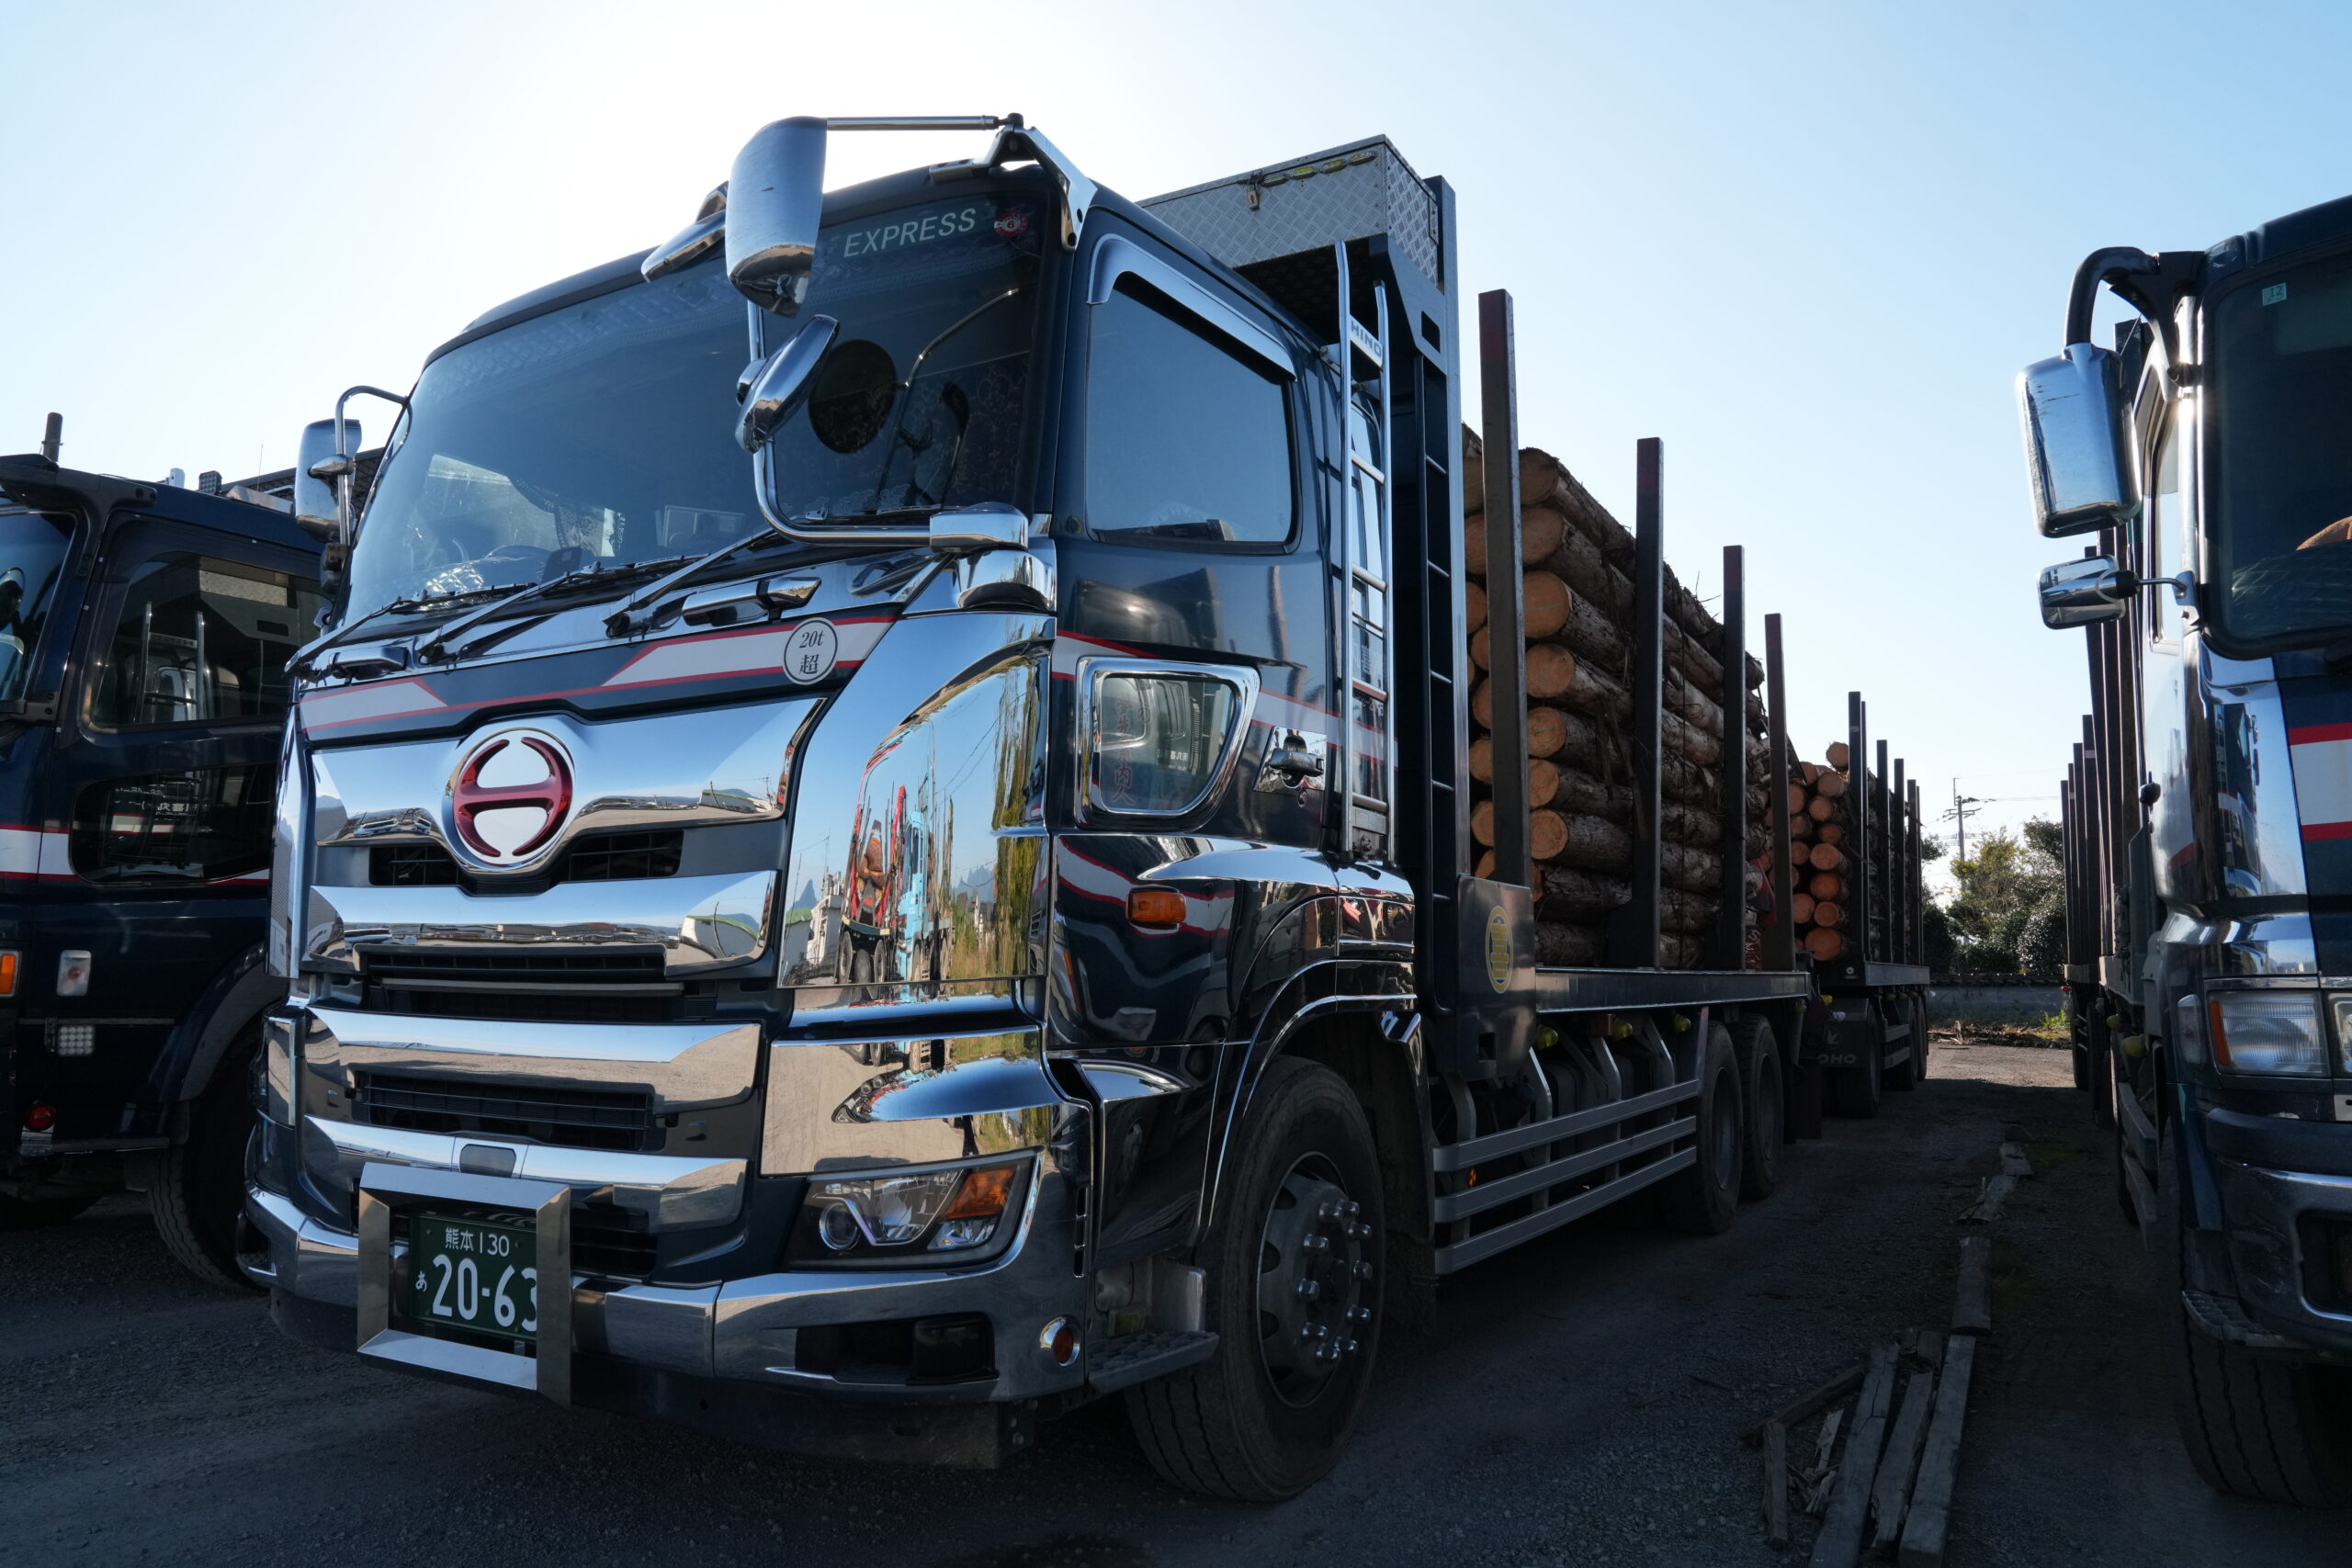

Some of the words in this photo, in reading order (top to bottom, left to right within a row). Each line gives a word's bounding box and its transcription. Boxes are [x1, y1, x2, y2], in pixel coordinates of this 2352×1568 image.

[842, 207, 977, 258] EXPRESS
[1350, 320, 1383, 359] HINO
[798, 630, 825, 649] 20t
[798, 654, 820, 675] 超
[415, 1270, 428, 1292] あ
